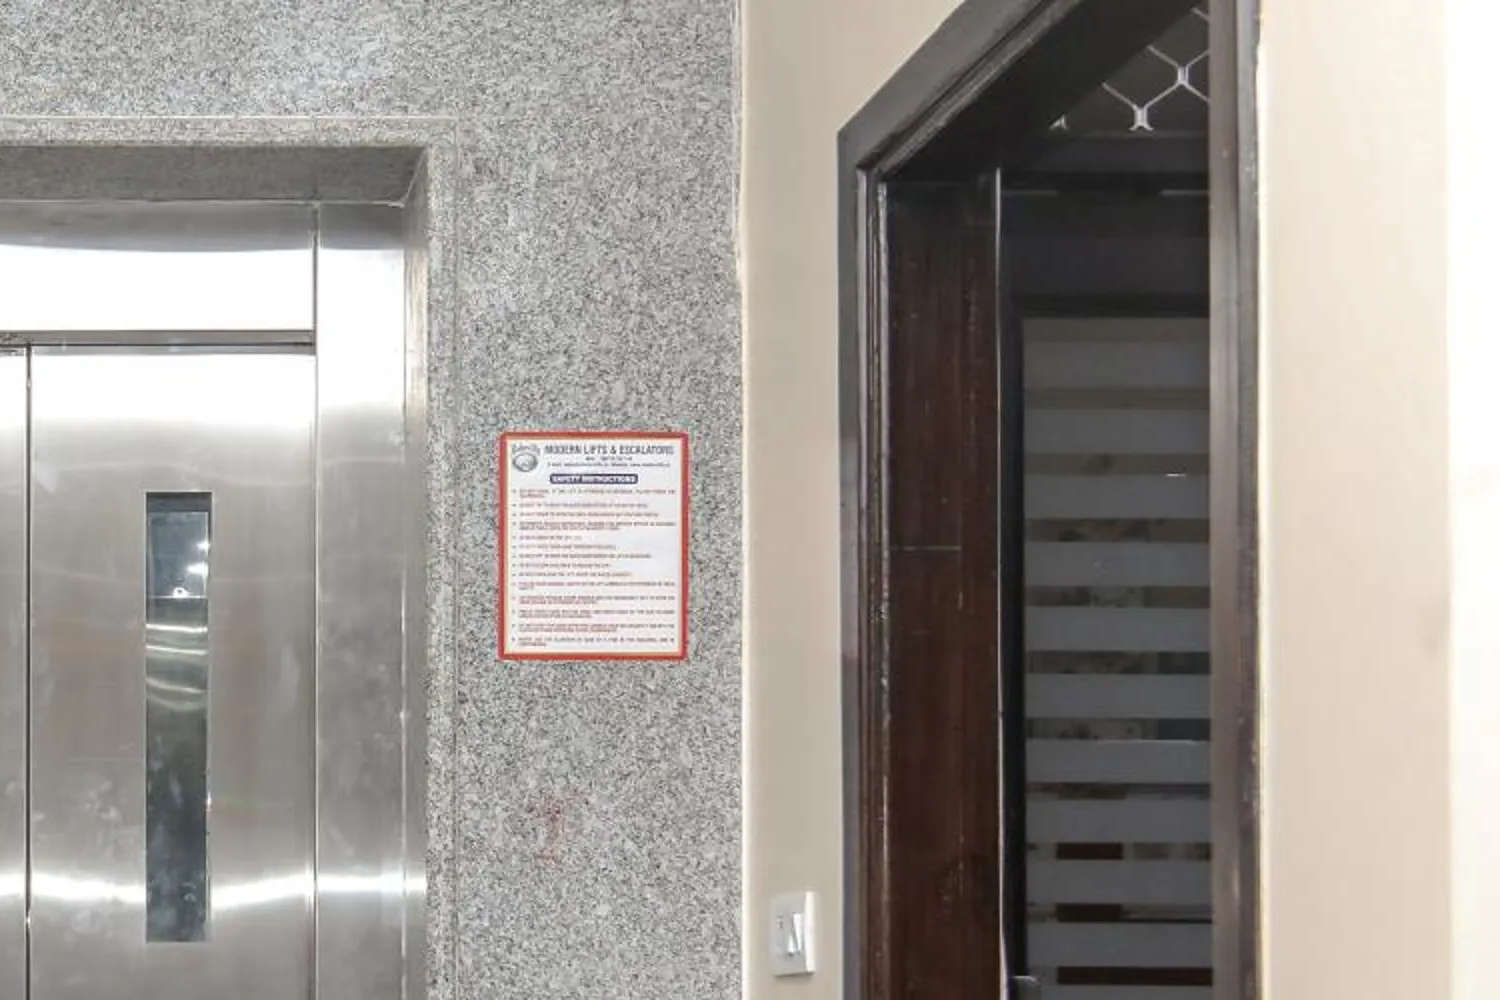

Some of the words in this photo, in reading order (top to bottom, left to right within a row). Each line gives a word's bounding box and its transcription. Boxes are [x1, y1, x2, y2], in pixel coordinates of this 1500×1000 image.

[544, 445, 581, 455] MODERN
[584, 445, 607, 455] LIFTS
[610, 445, 617, 455] &
[620, 445, 674, 455] ESCALATORS
